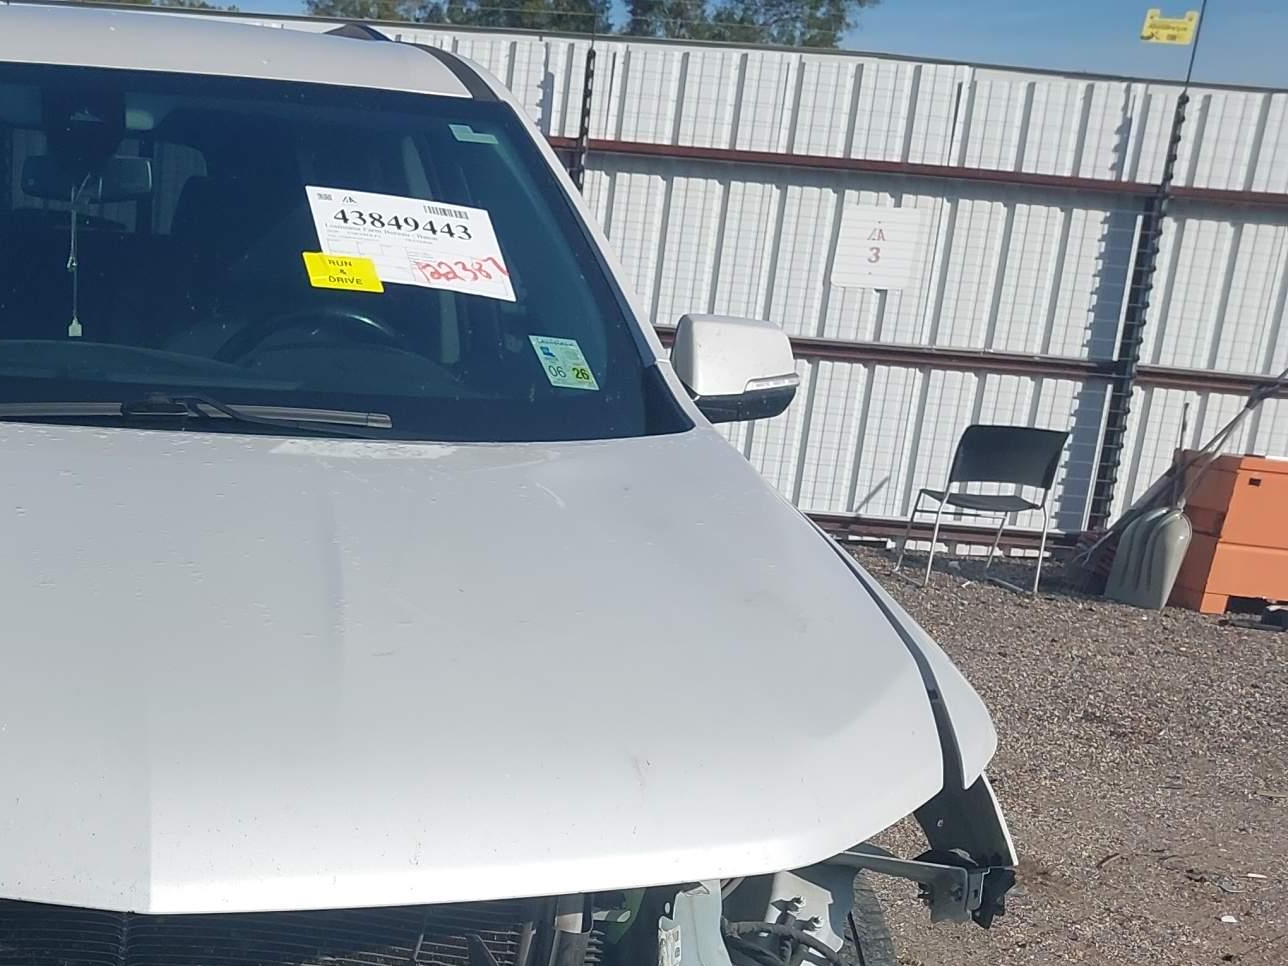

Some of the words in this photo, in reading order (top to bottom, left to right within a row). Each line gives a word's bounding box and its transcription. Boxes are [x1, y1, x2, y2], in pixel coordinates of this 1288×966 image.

[333, 208, 472, 241] 43849443
[867, 247, 881, 263] 3
[328, 259, 352, 267] RUN
[328, 275, 363, 285] DRIVE
[548, 365, 567, 378] 06
[572, 367, 590, 380] 26
